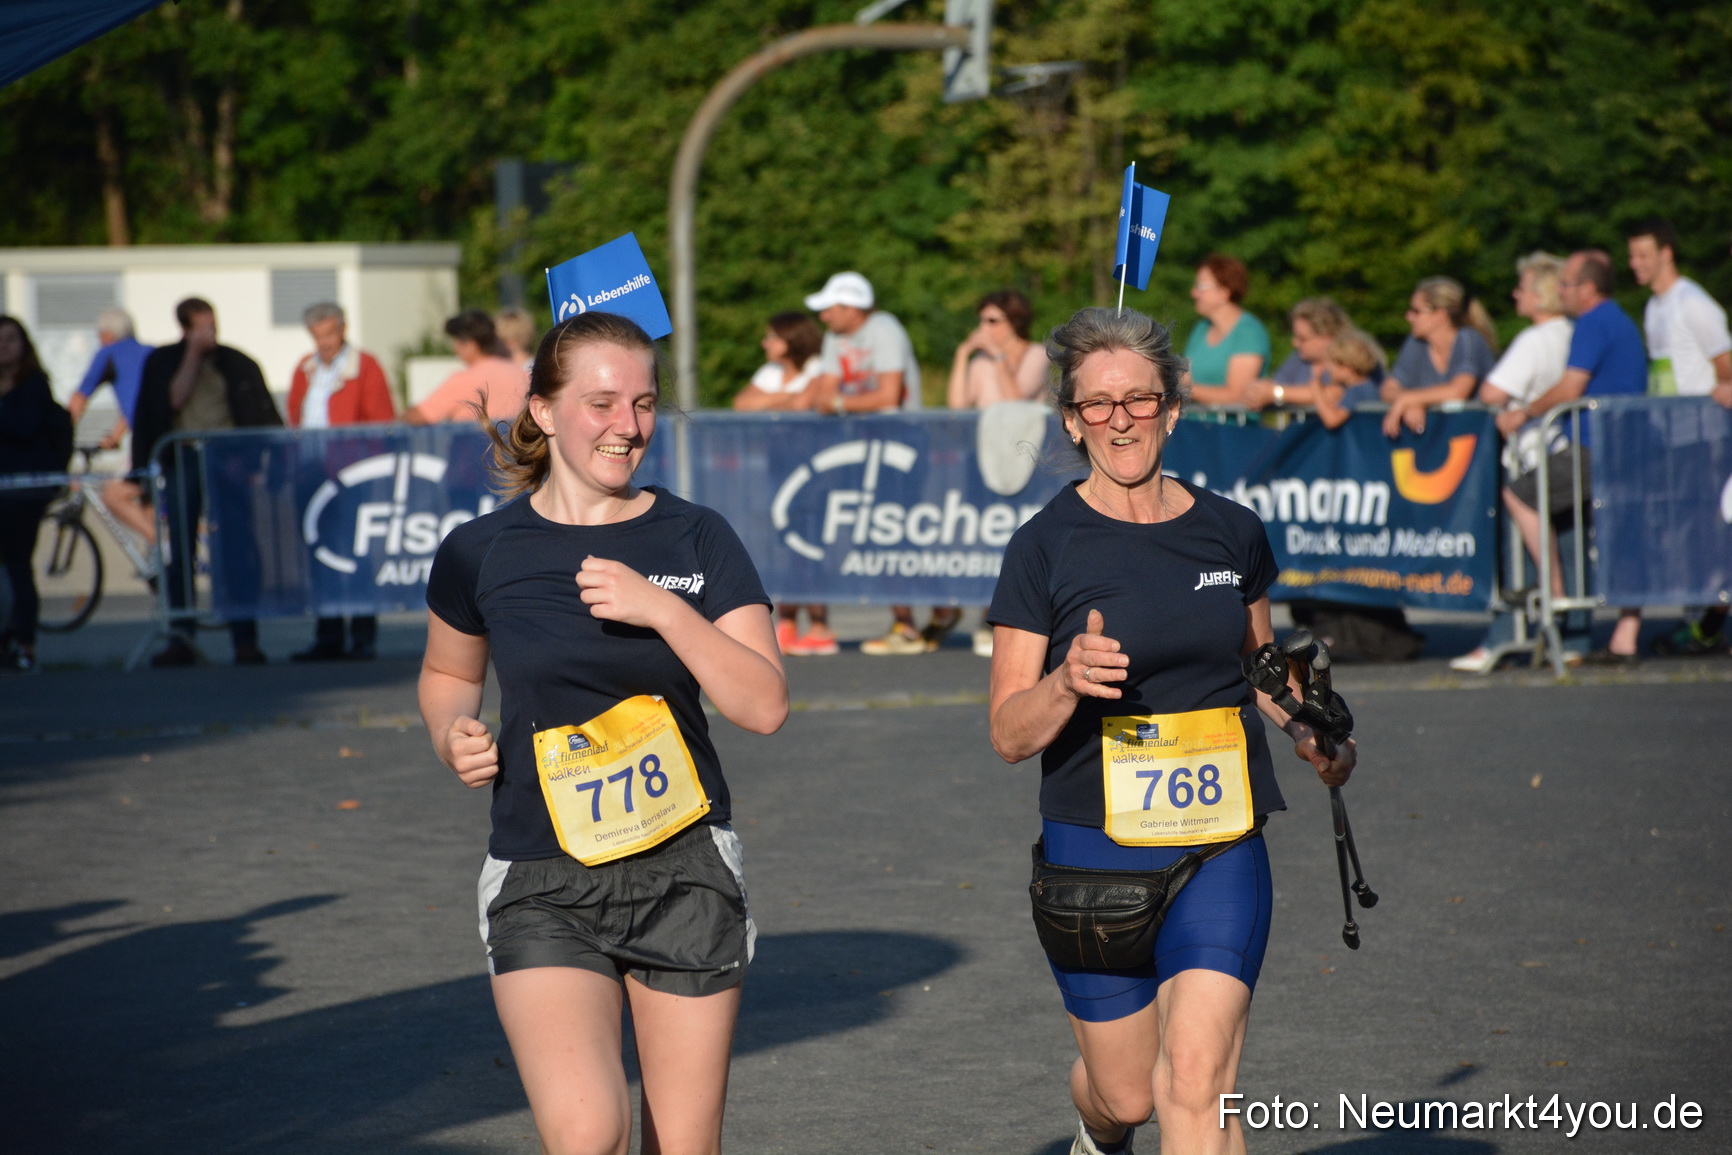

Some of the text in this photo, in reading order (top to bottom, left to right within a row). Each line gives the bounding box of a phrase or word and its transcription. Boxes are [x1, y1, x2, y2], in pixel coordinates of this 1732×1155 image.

[587, 273, 651, 307] Lebenshilfe
[1344, 528, 1391, 557] und
[1391, 527, 1476, 558] Medien
[1194, 570, 1232, 591] JURA
[560, 740, 609, 763] firmenlauf
[1126, 736, 1180, 748] firmenlauf
[1112, 752, 1155, 764] walken
[547, 765, 592, 782] walken
[575, 753, 669, 823] 778
[1135, 763, 1223, 811] 768
[594, 823, 641, 843] Demireva
[640, 802, 677, 830] Borislava
[1140, 816, 1220, 829] Gabriele Wittmann
